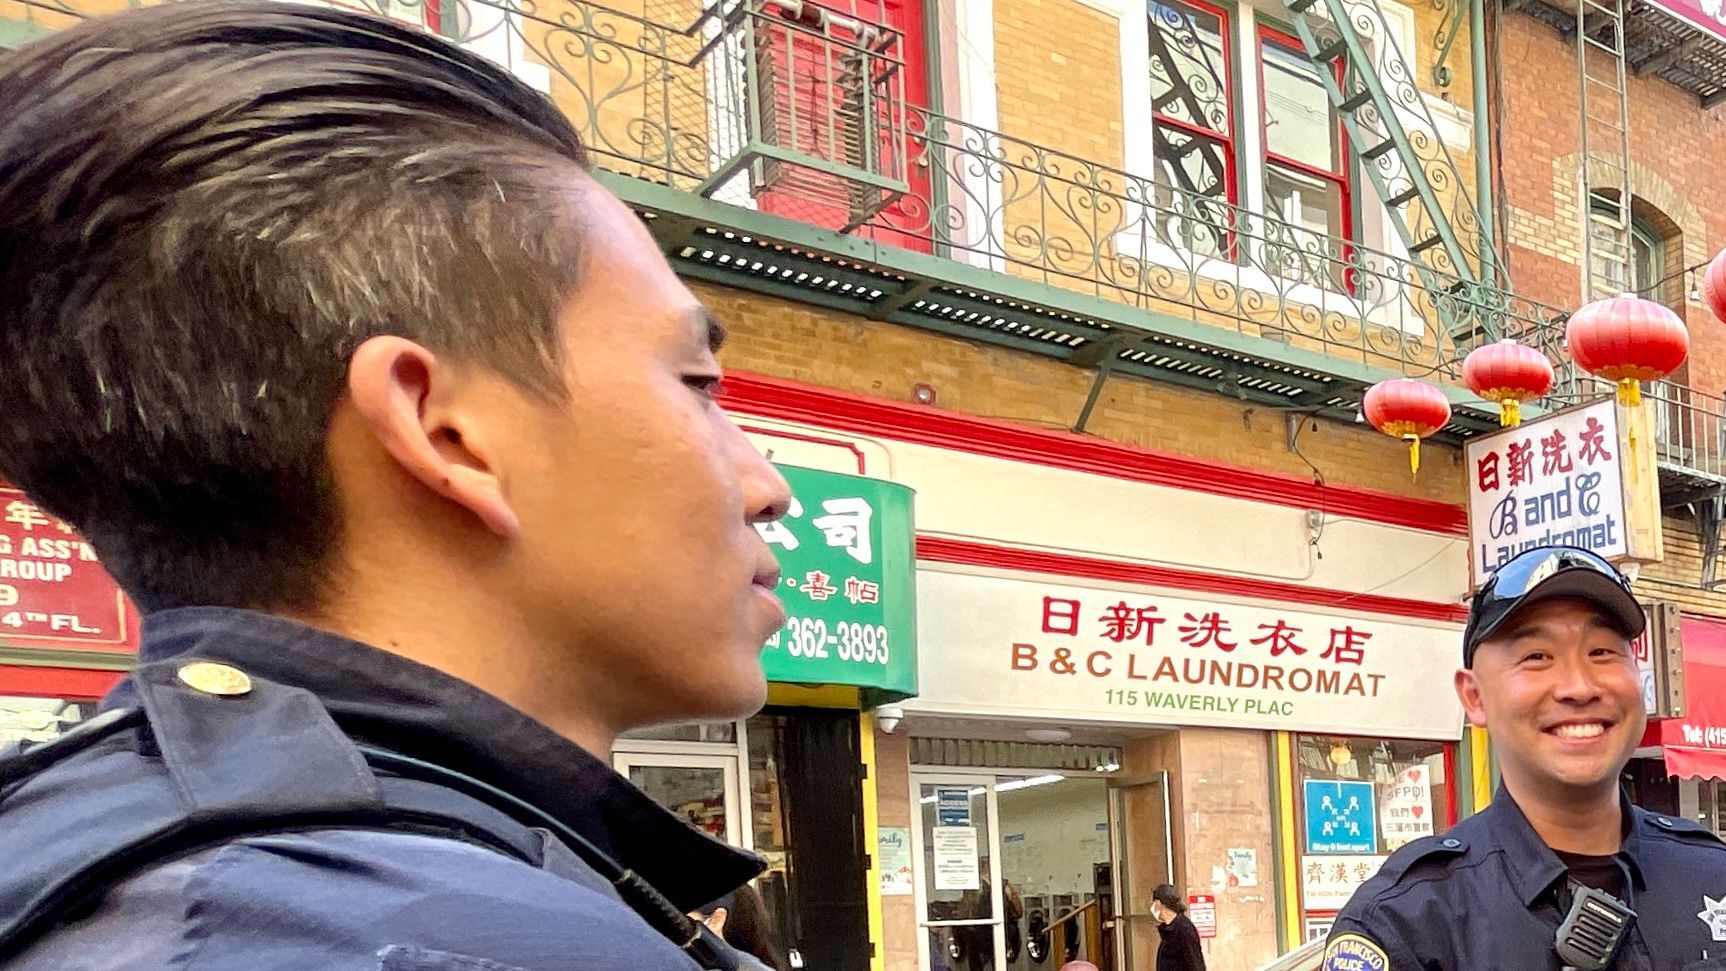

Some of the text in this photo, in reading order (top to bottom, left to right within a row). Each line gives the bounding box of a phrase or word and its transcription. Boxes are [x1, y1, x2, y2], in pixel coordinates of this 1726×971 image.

[1477, 416, 1612, 493] 日新洗衣
[1489, 489, 1519, 540] B
[1524, 476, 1572, 527] and
[51, 614, 102, 634] FL.
[787, 616, 889, 666] 362-3893
[1041, 595, 1373, 666] 日新洗衣店
[1011, 643, 1387, 698] B & C LAUNDROMAT
[1105, 688, 1295, 717] 115 WAVERLY PLAC
